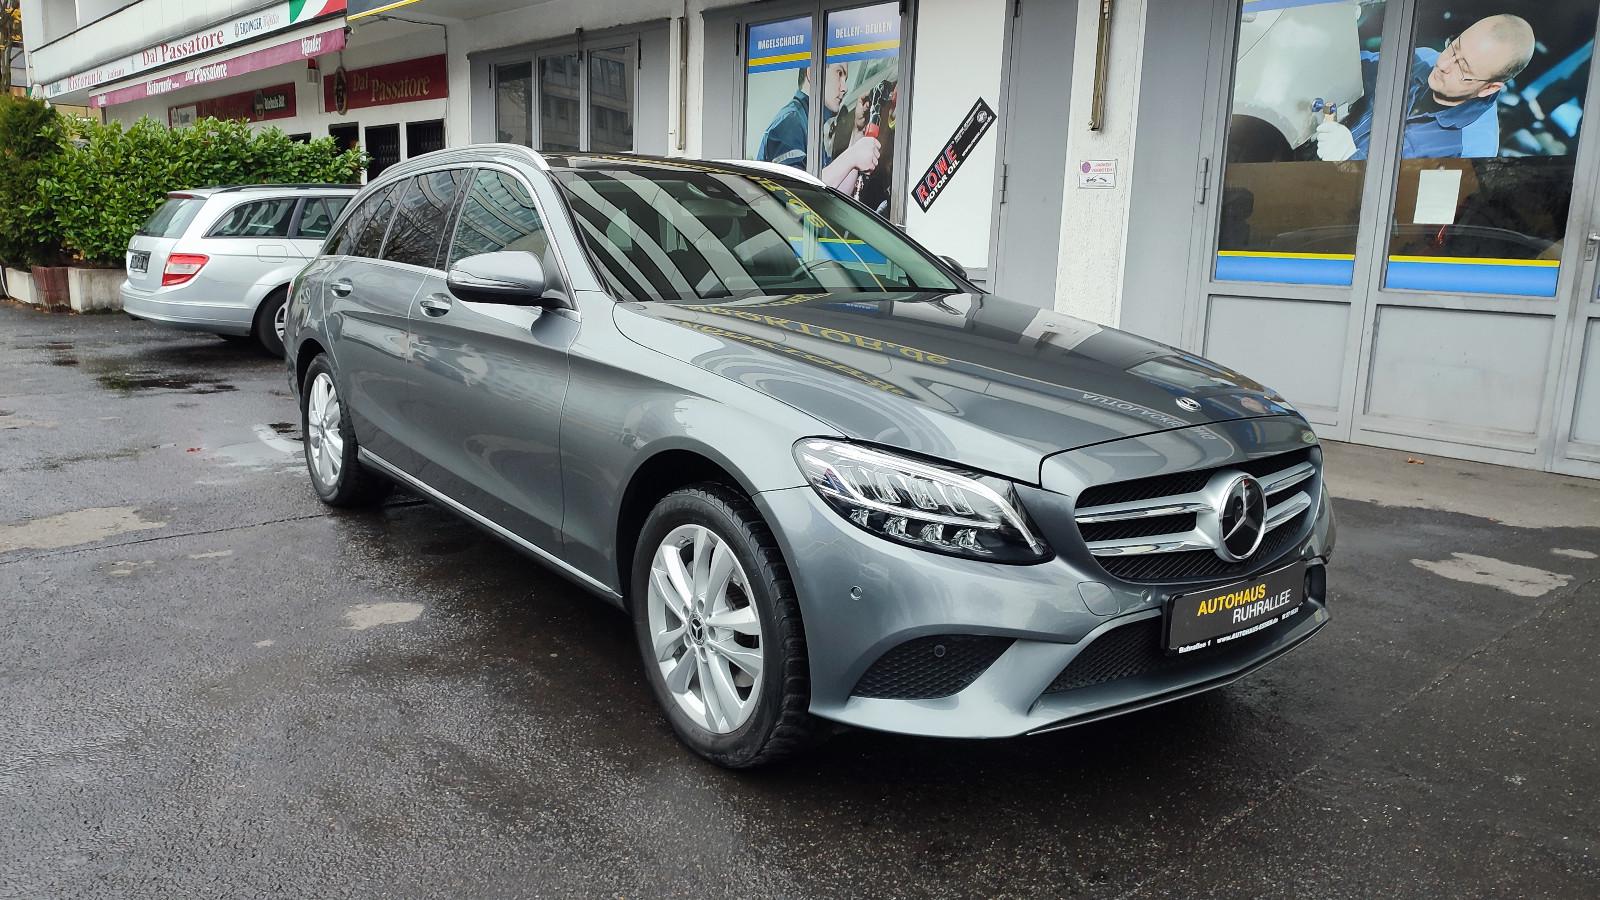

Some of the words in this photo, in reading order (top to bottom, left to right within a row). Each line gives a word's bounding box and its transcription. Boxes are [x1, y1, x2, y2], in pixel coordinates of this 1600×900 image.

[142, 46, 158, 66] Dal
[160, 30, 224, 62] Passatore
[194, 63, 228, 82] Passatore
[352, 72, 369, 91] Dal
[371, 76, 431, 102] Passatore
[916, 143, 958, 204] ROWE
[923, 174, 948, 208] MOTOR
[947, 160, 960, 175] OIL
[1196, 583, 1266, 616] AUTOHAUS
[1232, 588, 1292, 624] RUHRALLEE
